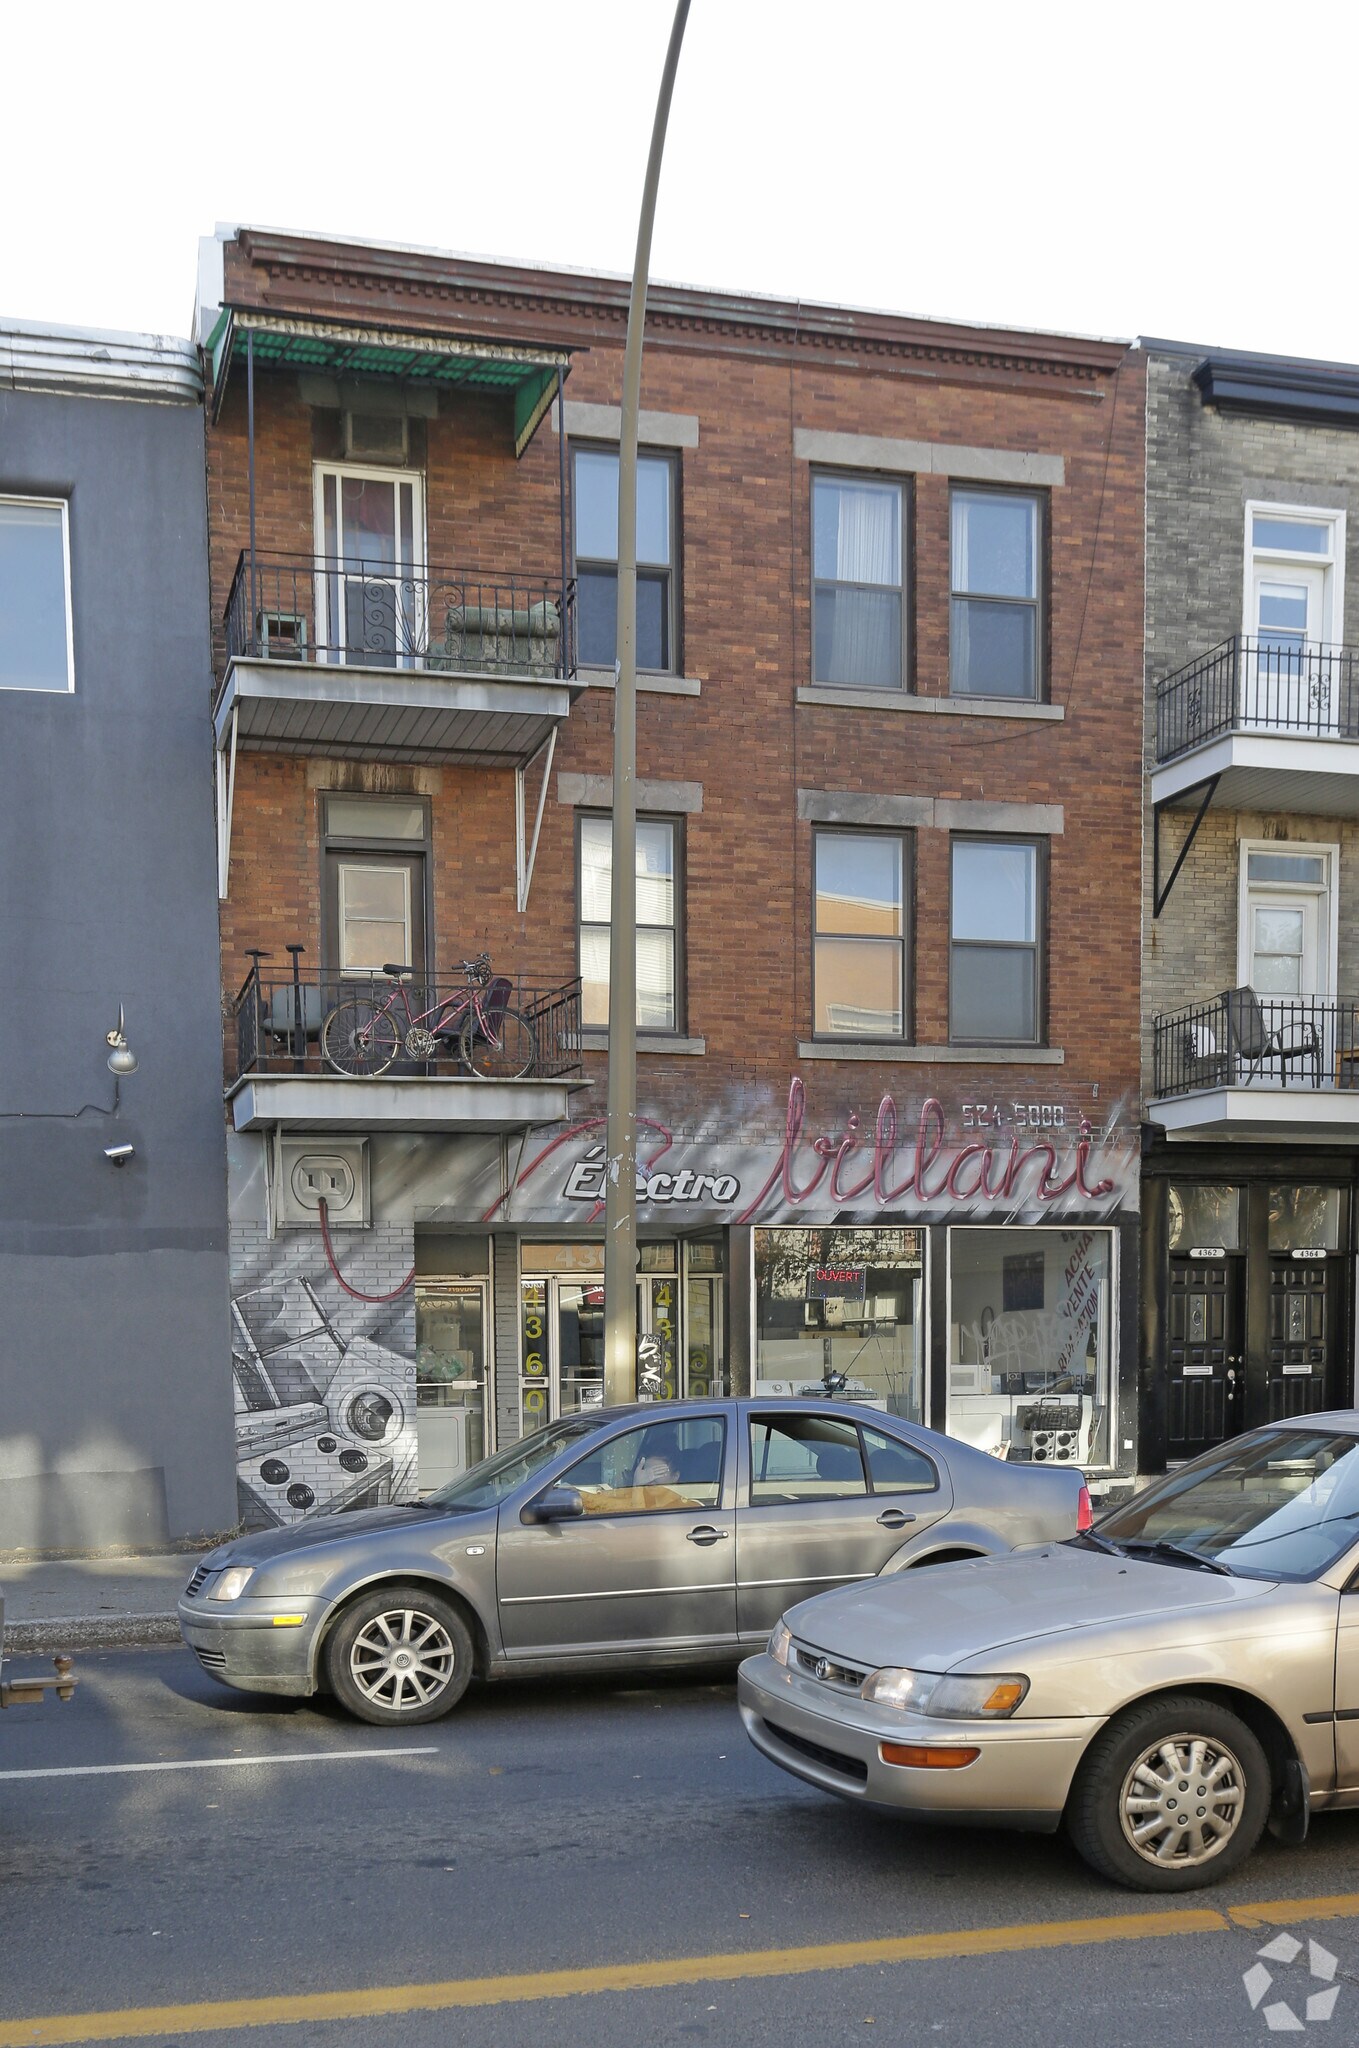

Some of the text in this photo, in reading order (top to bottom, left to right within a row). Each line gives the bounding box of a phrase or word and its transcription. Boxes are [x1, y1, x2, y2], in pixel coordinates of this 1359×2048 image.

[564, 1146, 740, 1203] Éctro
[555, 1245, 641, 1268] 43
[816, 1269, 860, 1282] OUVERT
[1064, 1232, 1096, 1288] ACHA
[1063, 1261, 1095, 1318] VENTE
